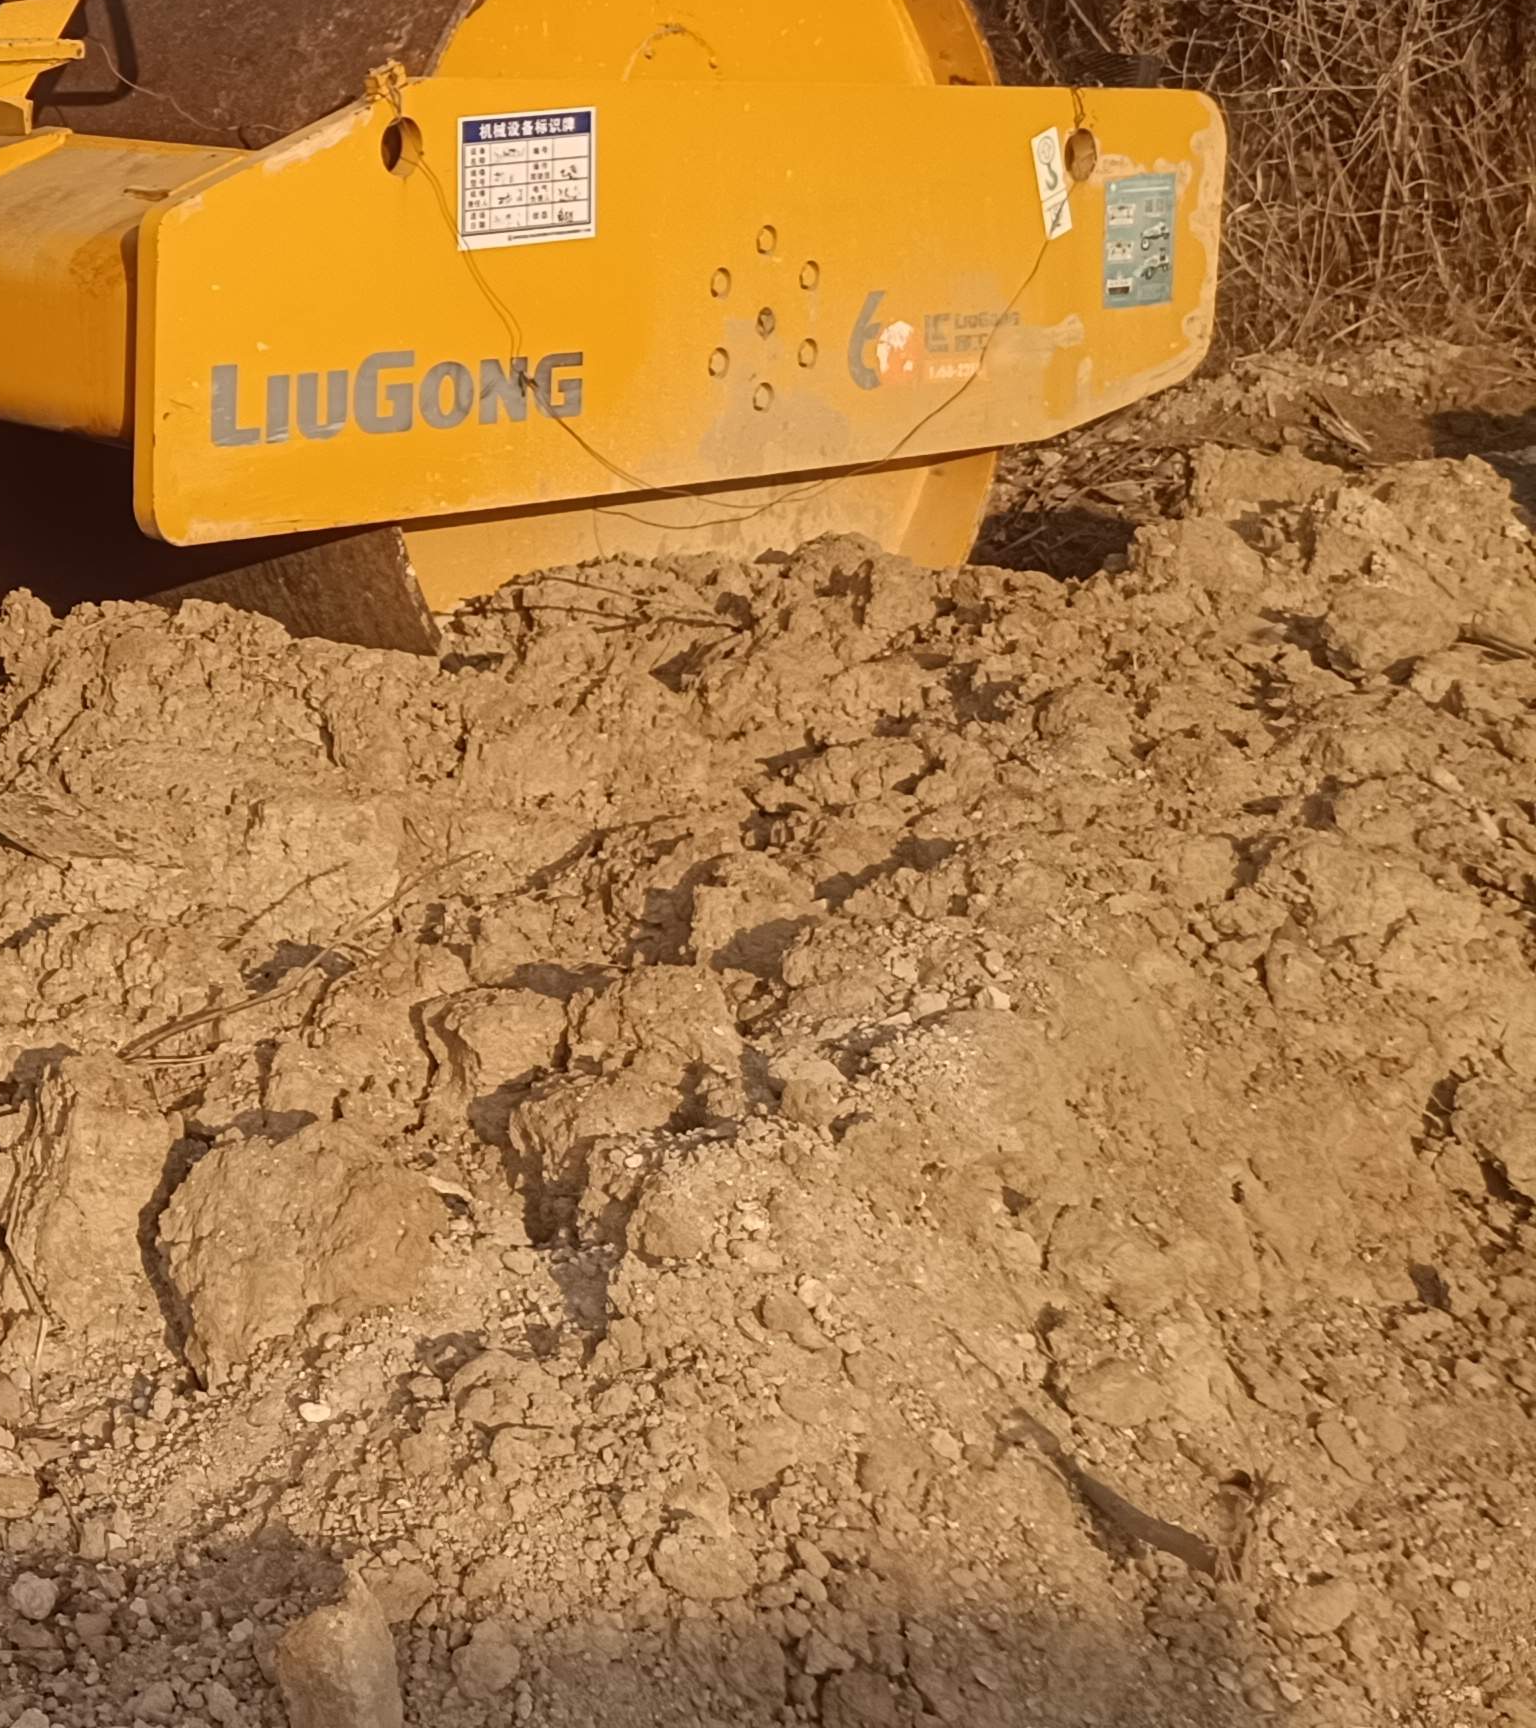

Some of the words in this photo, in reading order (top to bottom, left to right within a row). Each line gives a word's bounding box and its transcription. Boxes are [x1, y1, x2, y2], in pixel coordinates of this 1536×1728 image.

[479, 117, 575, 139] 机械设备标识牌
